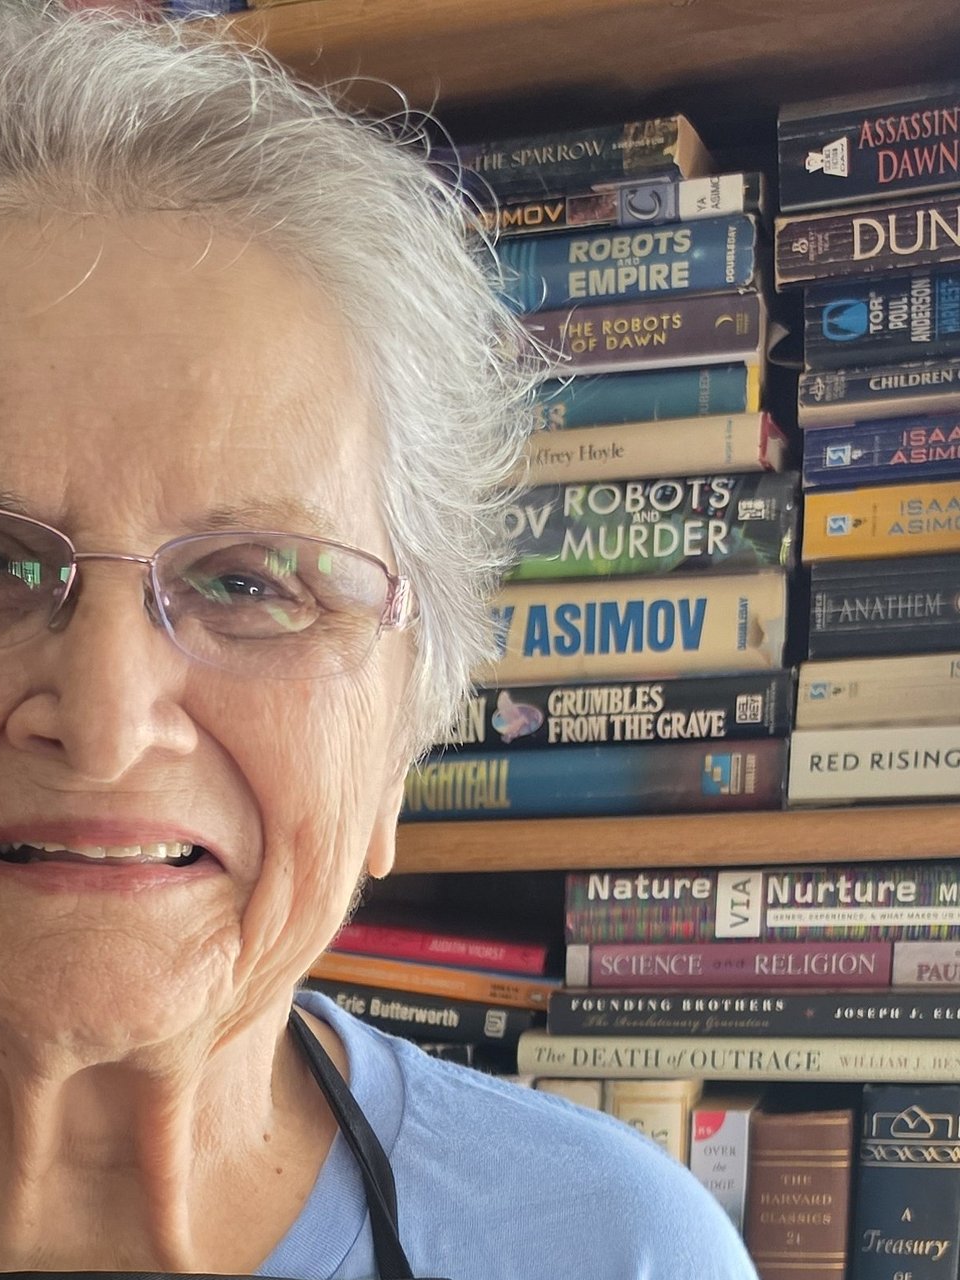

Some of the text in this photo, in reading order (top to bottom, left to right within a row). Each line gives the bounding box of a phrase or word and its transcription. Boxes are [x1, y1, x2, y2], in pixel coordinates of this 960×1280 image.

[471, 152, 510, 174] THE
[512, 139, 606, 170] SPARROW
[878, 139, 959, 184] DAWN
[697, 197, 707, 212] YA
[852, 205, 960, 261] DUN
[568, 229, 692, 264] ROBOTS
[725, 226, 737, 283] DOUBLEDAY
[617, 256, 641, 267] AND
[568, 262, 690, 299] EMPIRE
[889, 294, 908, 330] POUL
[910, 278, 931, 342] ANDERSON
[559, 313, 684, 339] THE ROBOTS
[571, 331, 668, 354] OF DAWN
[869, 368, 954, 391] CHILDREN
[579, 441, 625, 463] Hoyle
[563, 475, 732, 518] ROBOTS
[632, 510, 660, 524] AND
[561, 519, 730, 562] MURDER
[839, 592, 942, 624] ANATHEM
[523, 597, 708, 658] ASIMOV
[547, 685, 665, 717] GRUMBLES
[739, 696, 748, 722] DEL
[749, 694, 760, 721] REY
[547, 709, 727, 744] FROM THE GRAVE
[810, 749, 960, 773] RED RISING
[588, 873, 918, 929] Nature VIA Nurture
[880, 912, 904, 920] WHAT
[907, 912, 939, 920] MAKES
[600, 952, 877, 977] SCIENCE and RELIGION
[369, 998, 460, 1029] Butterworth
[570, 998, 786, 1013] FOUNDING BROTHERS
[833, 1006, 903, 1020] JOSEPH
[534, 1045, 567, 1065] The
[572, 1047, 661, 1071] DEATH
[667, 1046, 686, 1067] of
[689, 1047, 821, 1073] OUTRAGE
[840, 1053, 909, 1070] WILLIAM
[703, 1145, 737, 1157] OVER
[712, 1162, 728, 1173] the
[780, 1174, 812, 1186] THE
[760, 1193, 832, 1206] HARVARD
[760, 1211, 832, 1226] CLASSICS
[901, 1206, 913, 1223] A
[862, 1228, 951, 1261] Treasury
